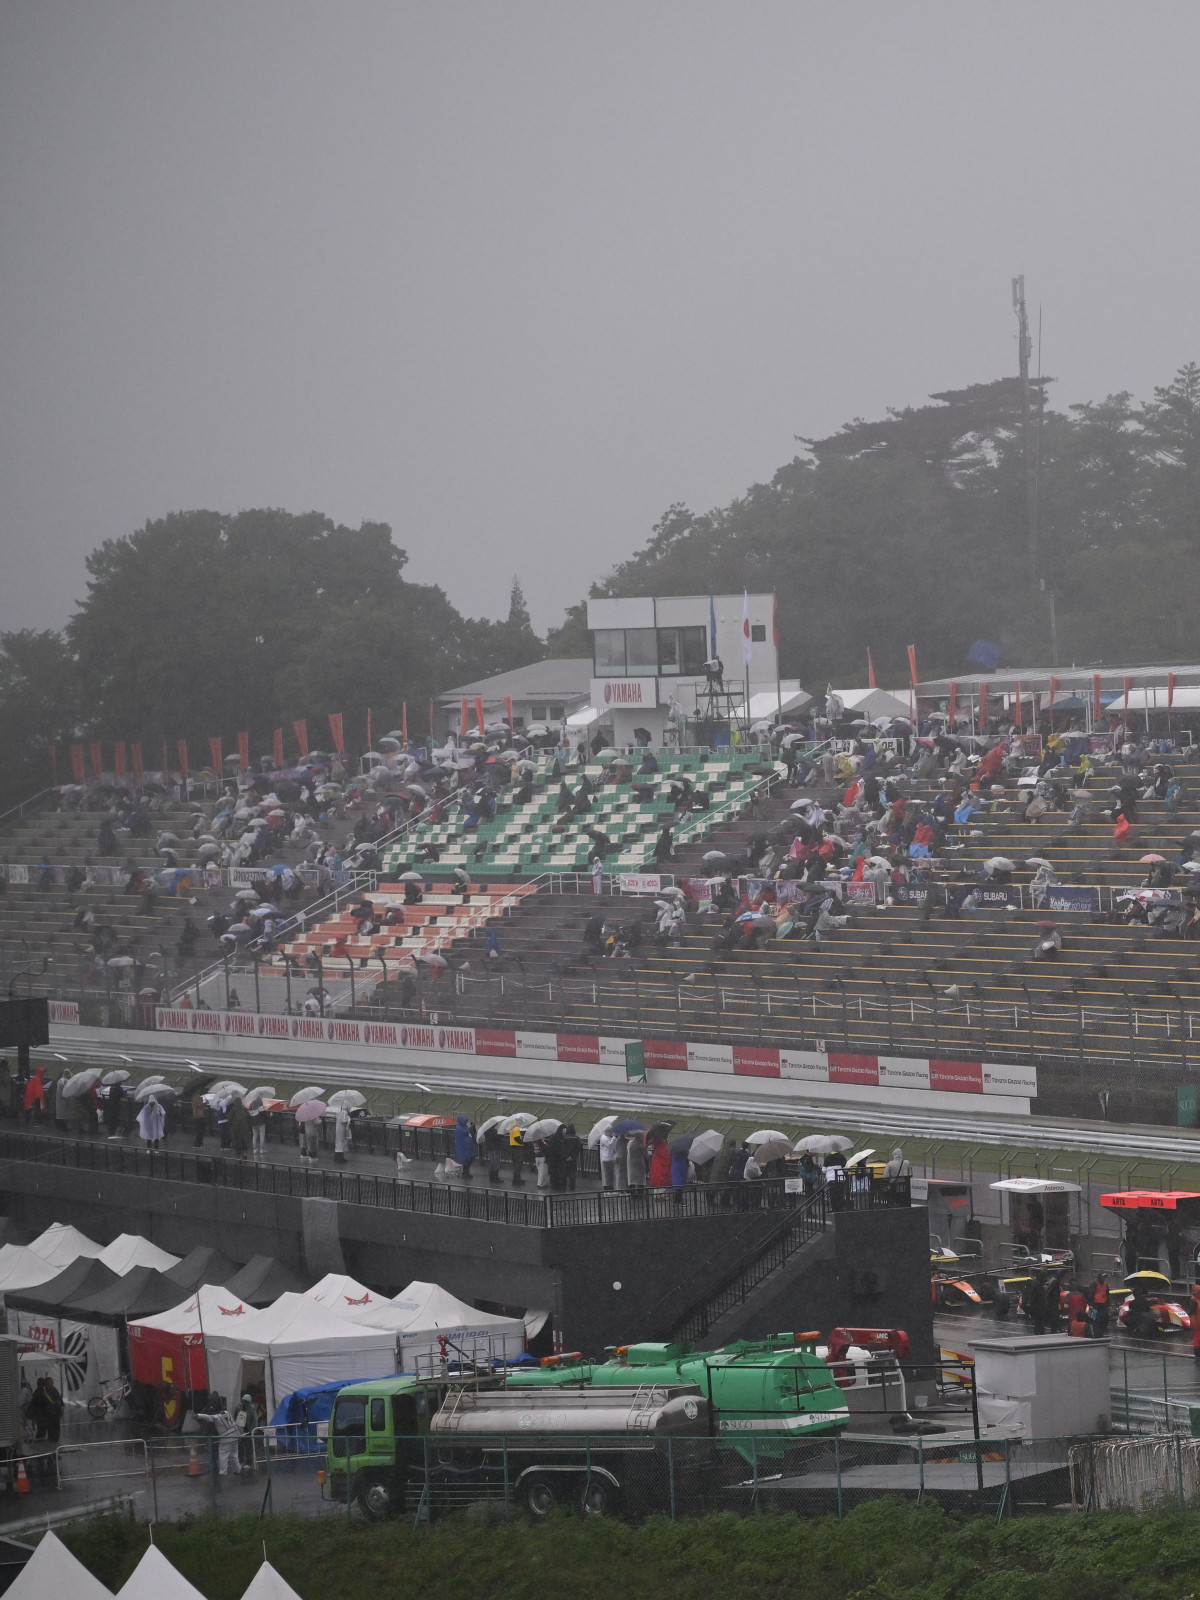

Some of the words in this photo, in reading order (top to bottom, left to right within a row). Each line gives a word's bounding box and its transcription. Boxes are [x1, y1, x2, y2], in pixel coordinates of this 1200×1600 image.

[612, 683, 642, 702] YAMAHA
[983, 891, 1008, 901] SUBARU
[163, 1011, 188, 1029] YAMAHA
[197, 1013, 222, 1031] YAMAHA
[230, 1015, 255, 1034] YAMAHA
[264, 1017, 289, 1036] YAMAHA
[297, 1020, 324, 1039] YAMAHA
[334, 1022, 360, 1042] YAMAHA
[370, 1025, 397, 1044] YAMAHA
[407, 1027, 435, 1048] YAMAHA
[445, 1030, 473, 1050] YAMAHA
[1112, 1198, 1126, 1206] ARTA
[1150, 1199, 1164, 1207] ARTA
[730, 1420, 752, 1430] SUGO
